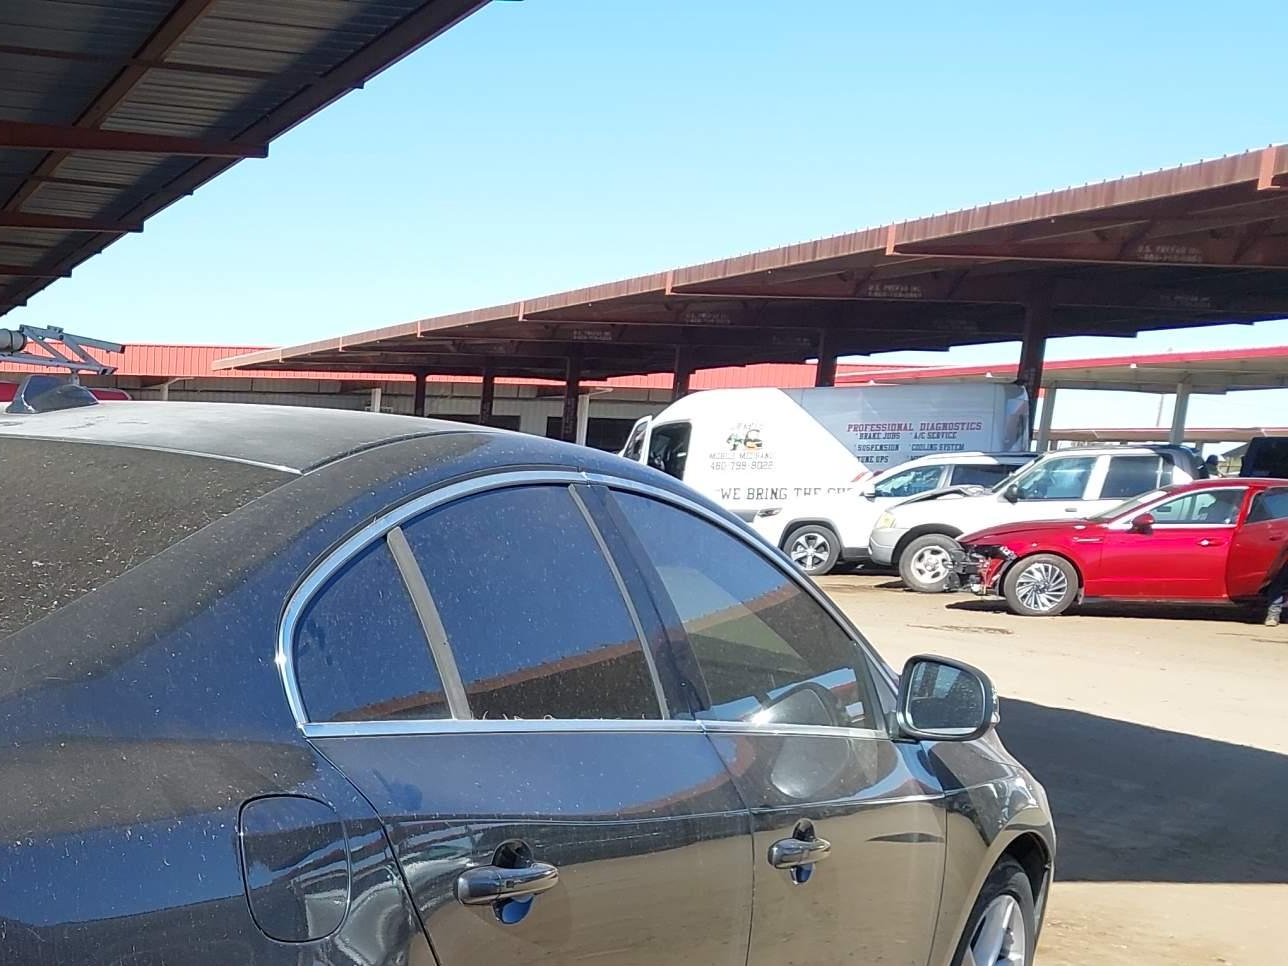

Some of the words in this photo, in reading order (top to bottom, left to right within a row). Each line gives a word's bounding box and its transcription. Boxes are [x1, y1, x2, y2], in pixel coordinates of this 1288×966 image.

[847, 422, 914, 432] PROFESSIONAL
[919, 421, 983, 431] DIAGNOSTICS
[882, 432, 901, 440] JOBS
[926, 431, 958, 440] SERVICE
[857, 444, 899, 452] SUSPENSION
[938, 443, 965, 451] SYSTEM
[746, 487, 788, 500] BRING
